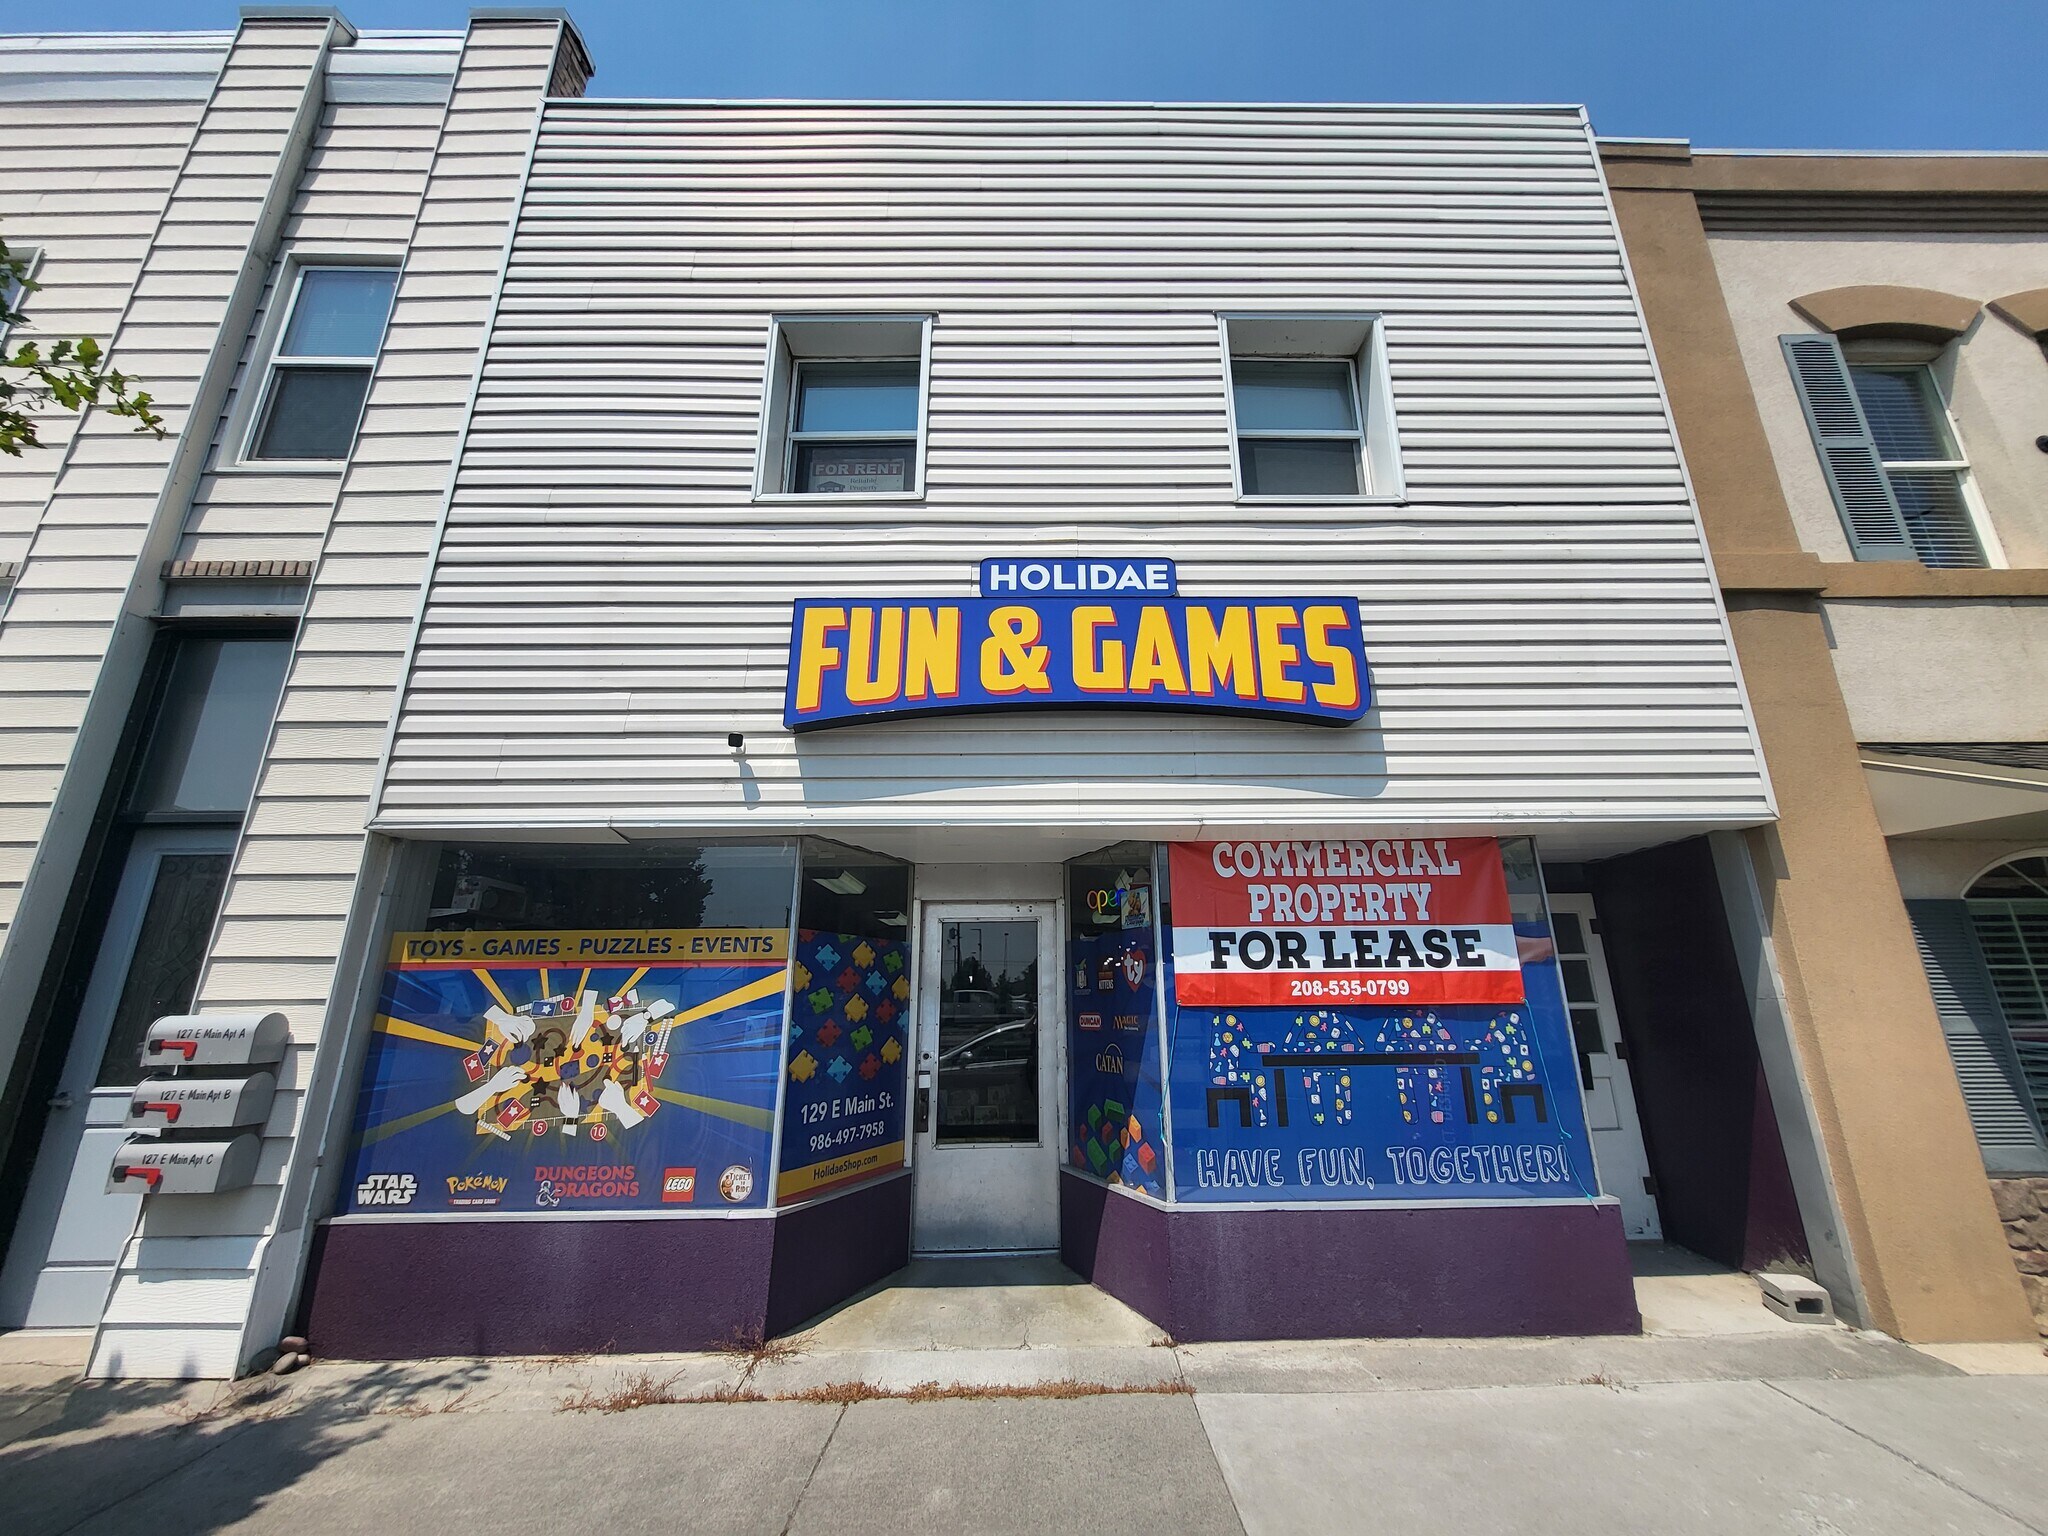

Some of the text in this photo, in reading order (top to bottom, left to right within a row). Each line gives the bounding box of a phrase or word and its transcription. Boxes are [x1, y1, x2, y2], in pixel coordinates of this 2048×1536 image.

[815, 463, 900, 475] FOR RENT
[990, 564, 1169, 591] HOLIDAE
[796, 605, 1360, 713] FUN & GAMES
[1212, 840, 1462, 878] COMMERCIAL
[1247, 882, 1432, 923] PROPERTY
[408, 938, 464, 957] TOYS
[483, 937, 561, 956] GAMES
[579, 936, 672, 955] PUZZLES
[691, 935, 774, 954] EVENTS
[1208, 928, 1487, 970] FOR LEASE
[1123, 953, 1144, 985] ty
[1290, 979, 1410, 997] 208-535-0799
[176, 1028, 246, 1041] 127 E Main Apt A
[1095, 1053, 1124, 1075] CATAN
[160, 1089, 232, 1103] 127 E Main Apt B
[800, 1091, 894, 1125] 129 E Main St.
[592, 1126, 605, 1138] 10
[809, 1120, 885, 1152] 986-497-7958
[142, 1153, 214, 1167] 127 E Main Apt C
[813, 1154, 878, 1181] HolidaeShop.com
[1196, 1144, 1571, 1191] HAVE FUN, TOGETHER!
[358, 1174, 418, 1190] STAR
[534, 1165, 635, 1182] DUNGEONS
[664, 1175, 695, 1192] LEGO
[357, 1189, 417, 1205] WARS
[554, 1181, 640, 1198] DRAGONS
